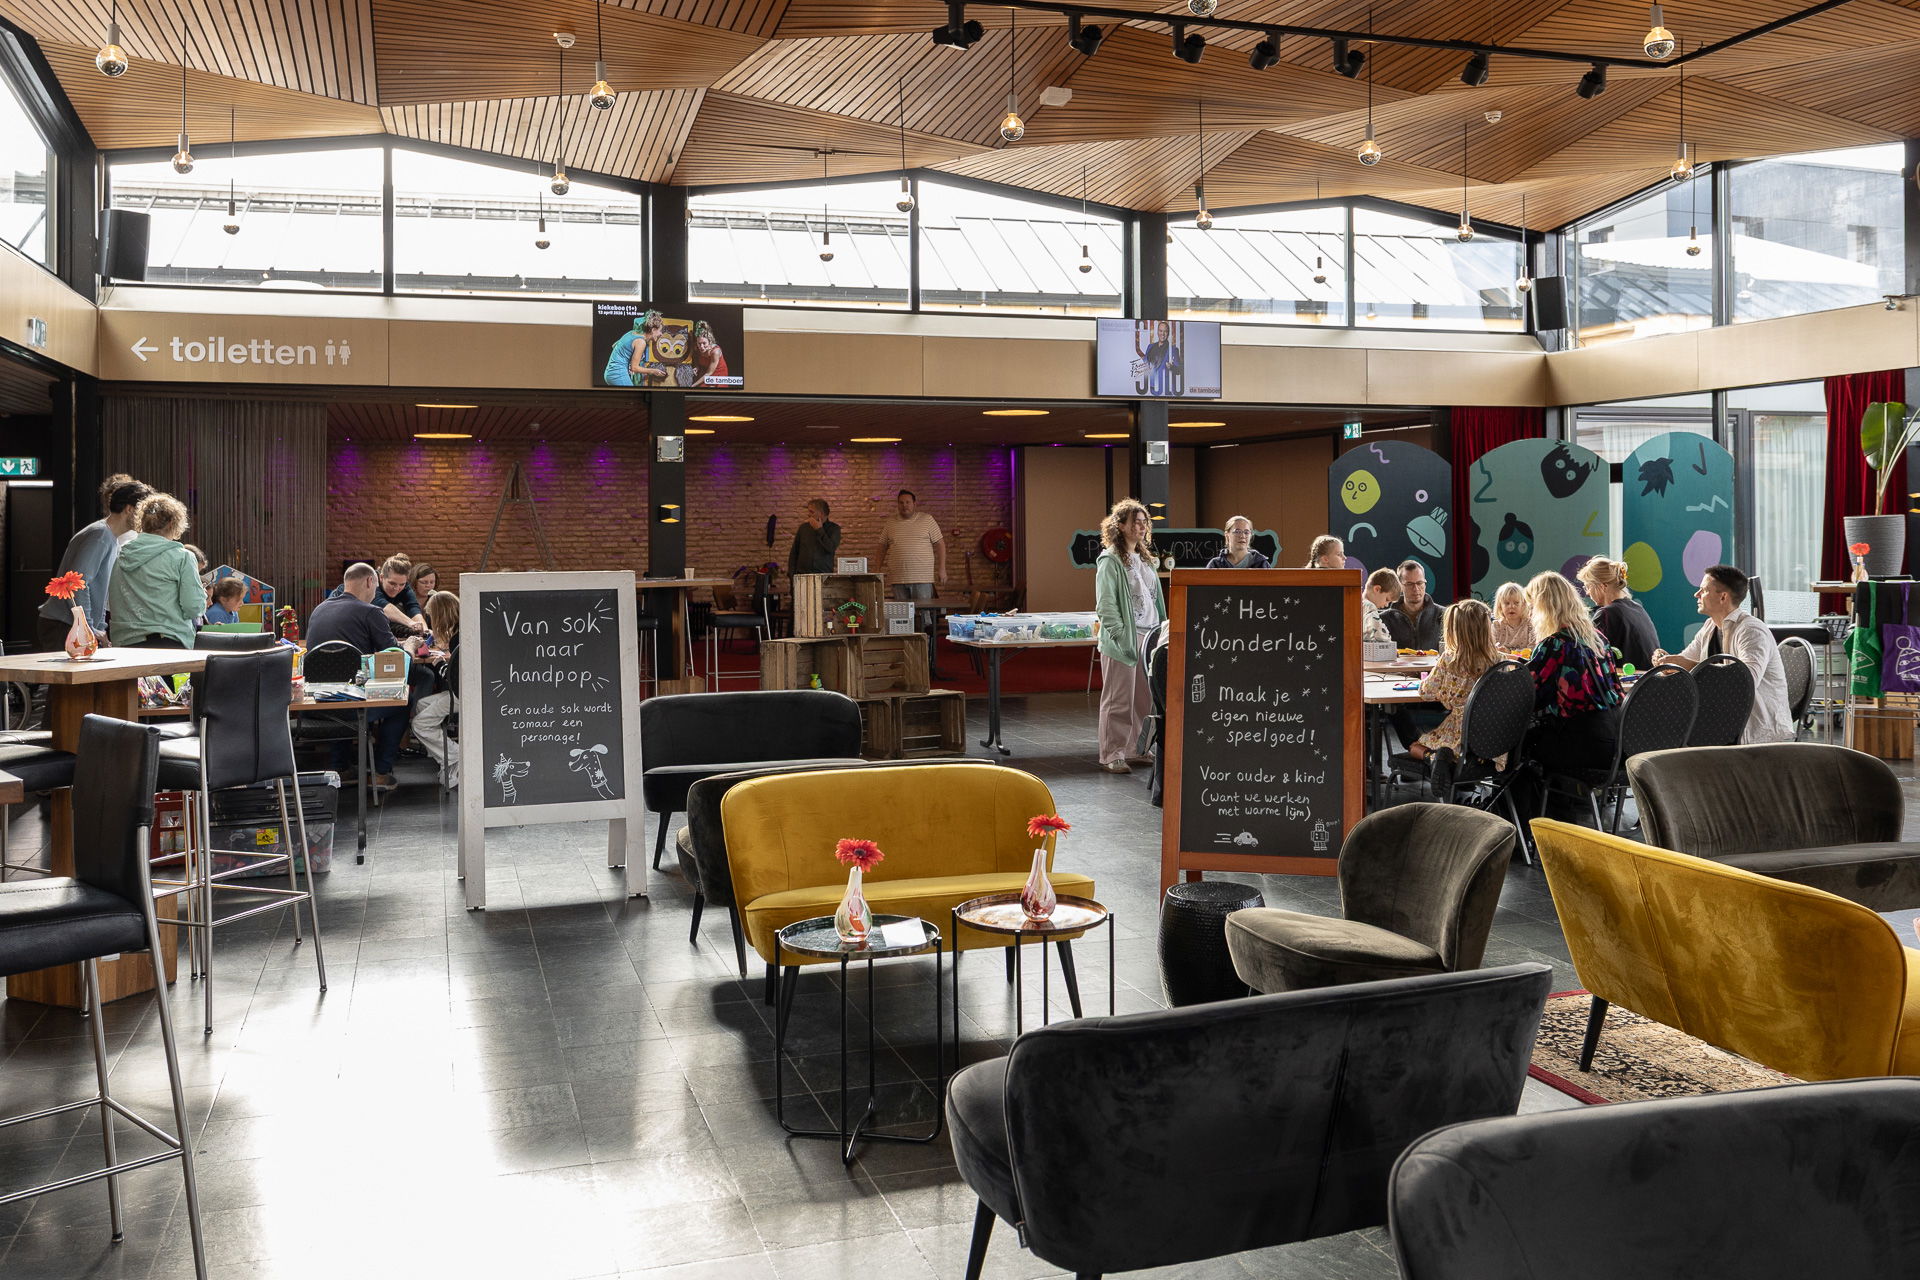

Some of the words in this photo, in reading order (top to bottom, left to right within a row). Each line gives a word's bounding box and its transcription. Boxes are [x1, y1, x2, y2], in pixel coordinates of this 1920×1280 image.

[169, 336, 317, 365] toiletten
[1189, 386, 1197, 394] de
[1239, 599, 1279, 620] Het
[503, 611, 549, 637] Van
[561, 612, 601, 634] sok
[1200, 627, 1318, 653] Wonderlab
[535, 643, 584, 658] naar
[509, 663, 592, 689] handpop
[1219, 685, 1267, 703] Maak
[1273, 689, 1291, 707] je
[500, 704, 521, 717] Een
[525, 703, 554, 715] oude
[561, 703, 580, 714] sok
[584, 701, 613, 714] wordt
[1211, 708, 1249, 728] eigen
[1255, 709, 1305, 724] nieuwe
[512, 719, 556, 730] zomaar
[562, 719, 583, 728] een
[520, 732, 582, 748] personage!
[1199, 765, 1232, 781] Voor
[1236, 767, 1276, 784] ouder
[1282, 771, 1291, 784] &
[1294, 768, 1325, 785] kind
[1200, 787, 1241, 807] (want
[1244, 792, 1262, 803] we
[1264, 791, 1310, 805] werken
[1218, 805, 1240, 817] met
[1244, 806, 1281, 816] warme
